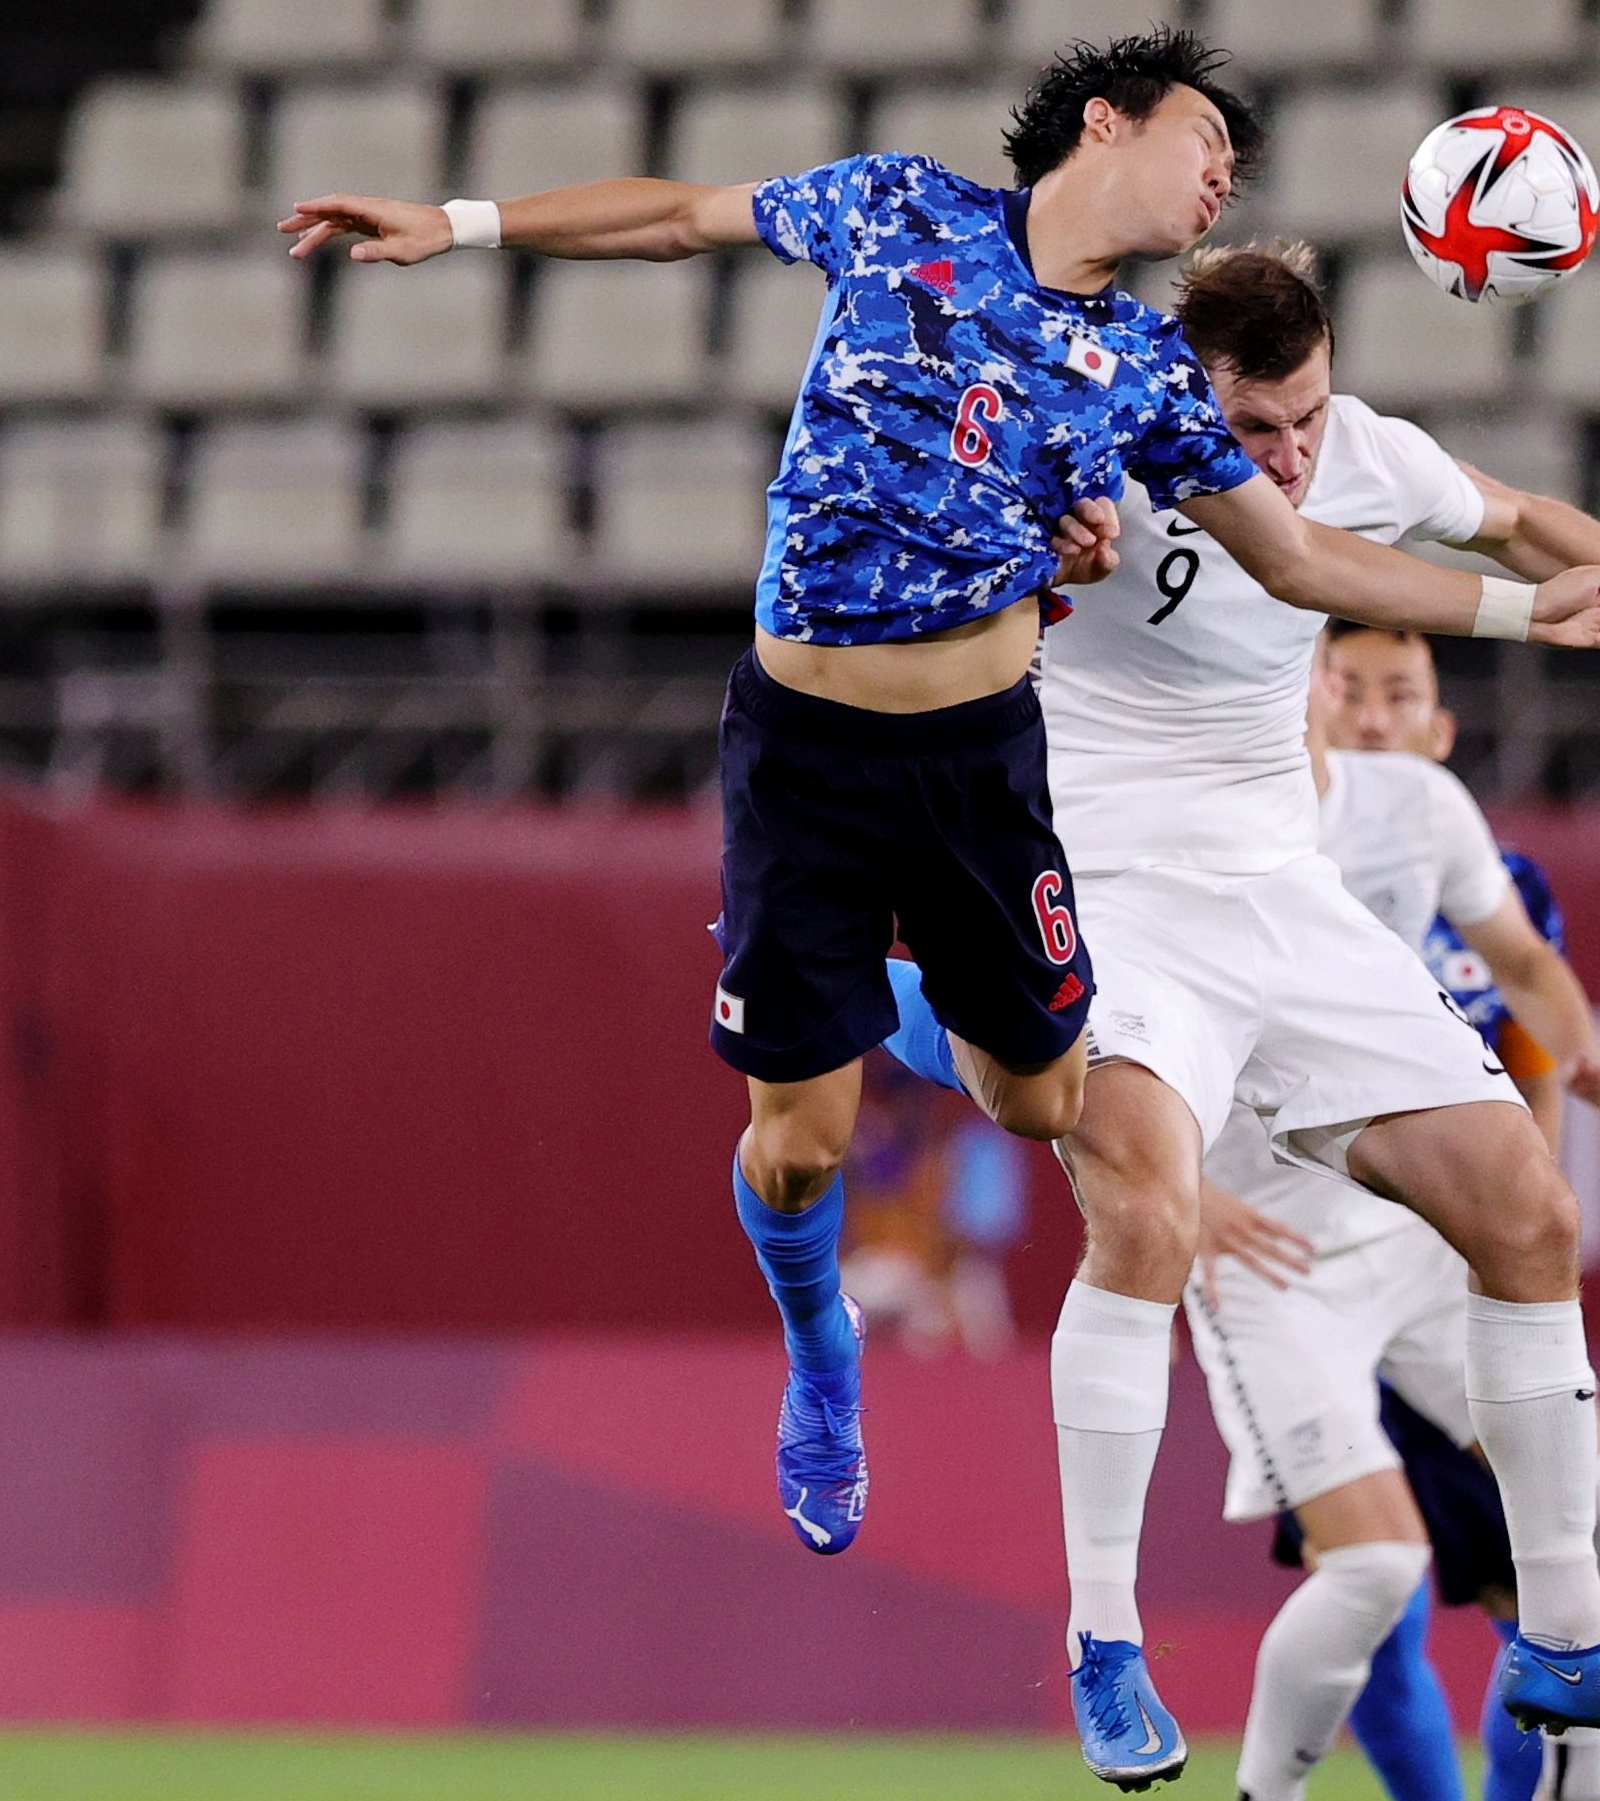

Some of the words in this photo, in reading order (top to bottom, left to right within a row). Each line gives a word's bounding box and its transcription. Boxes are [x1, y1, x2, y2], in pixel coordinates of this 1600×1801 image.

[909, 267, 958, 297] adidas
[950, 383, 1003, 468] 6
[1147, 548, 1200, 625] 9
[1031, 869, 1077, 966] 6
